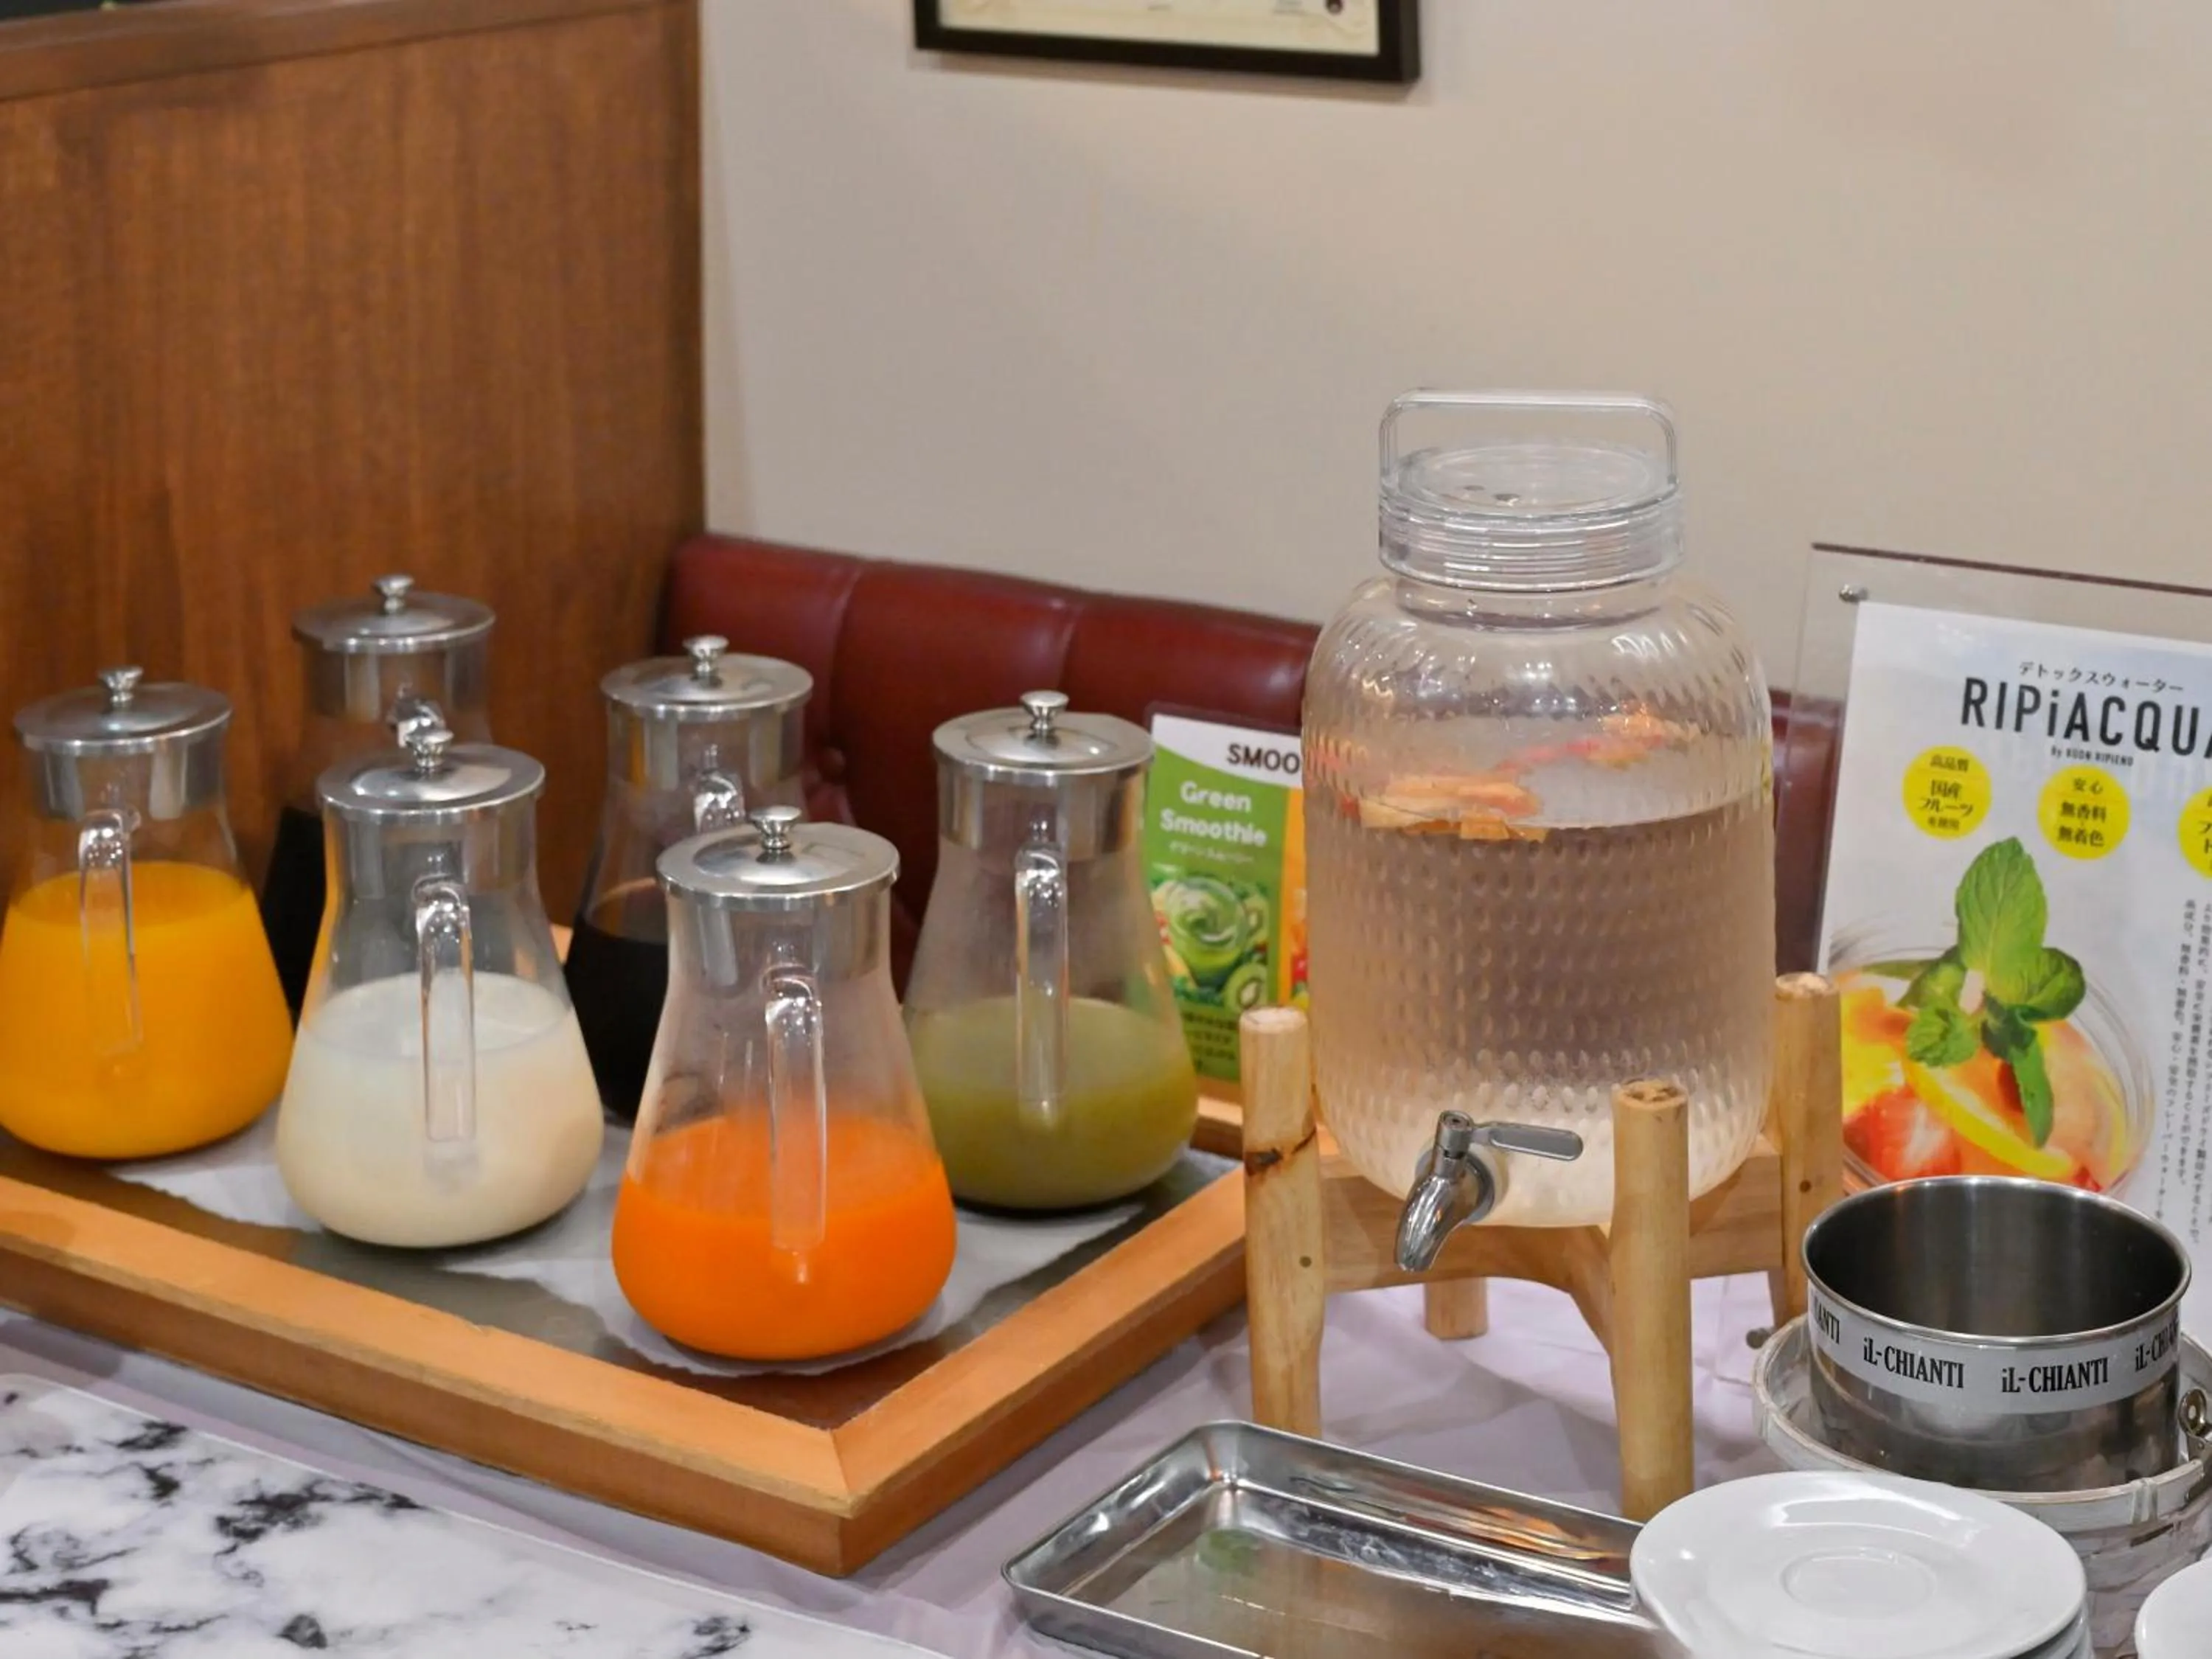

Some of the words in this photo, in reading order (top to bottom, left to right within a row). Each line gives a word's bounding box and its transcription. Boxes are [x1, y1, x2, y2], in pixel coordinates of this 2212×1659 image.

[2019, 661, 2184, 693] デトックスウォーター
[1180, 780, 1253, 812] Green
[1159, 808, 1268, 846] Smoothie
